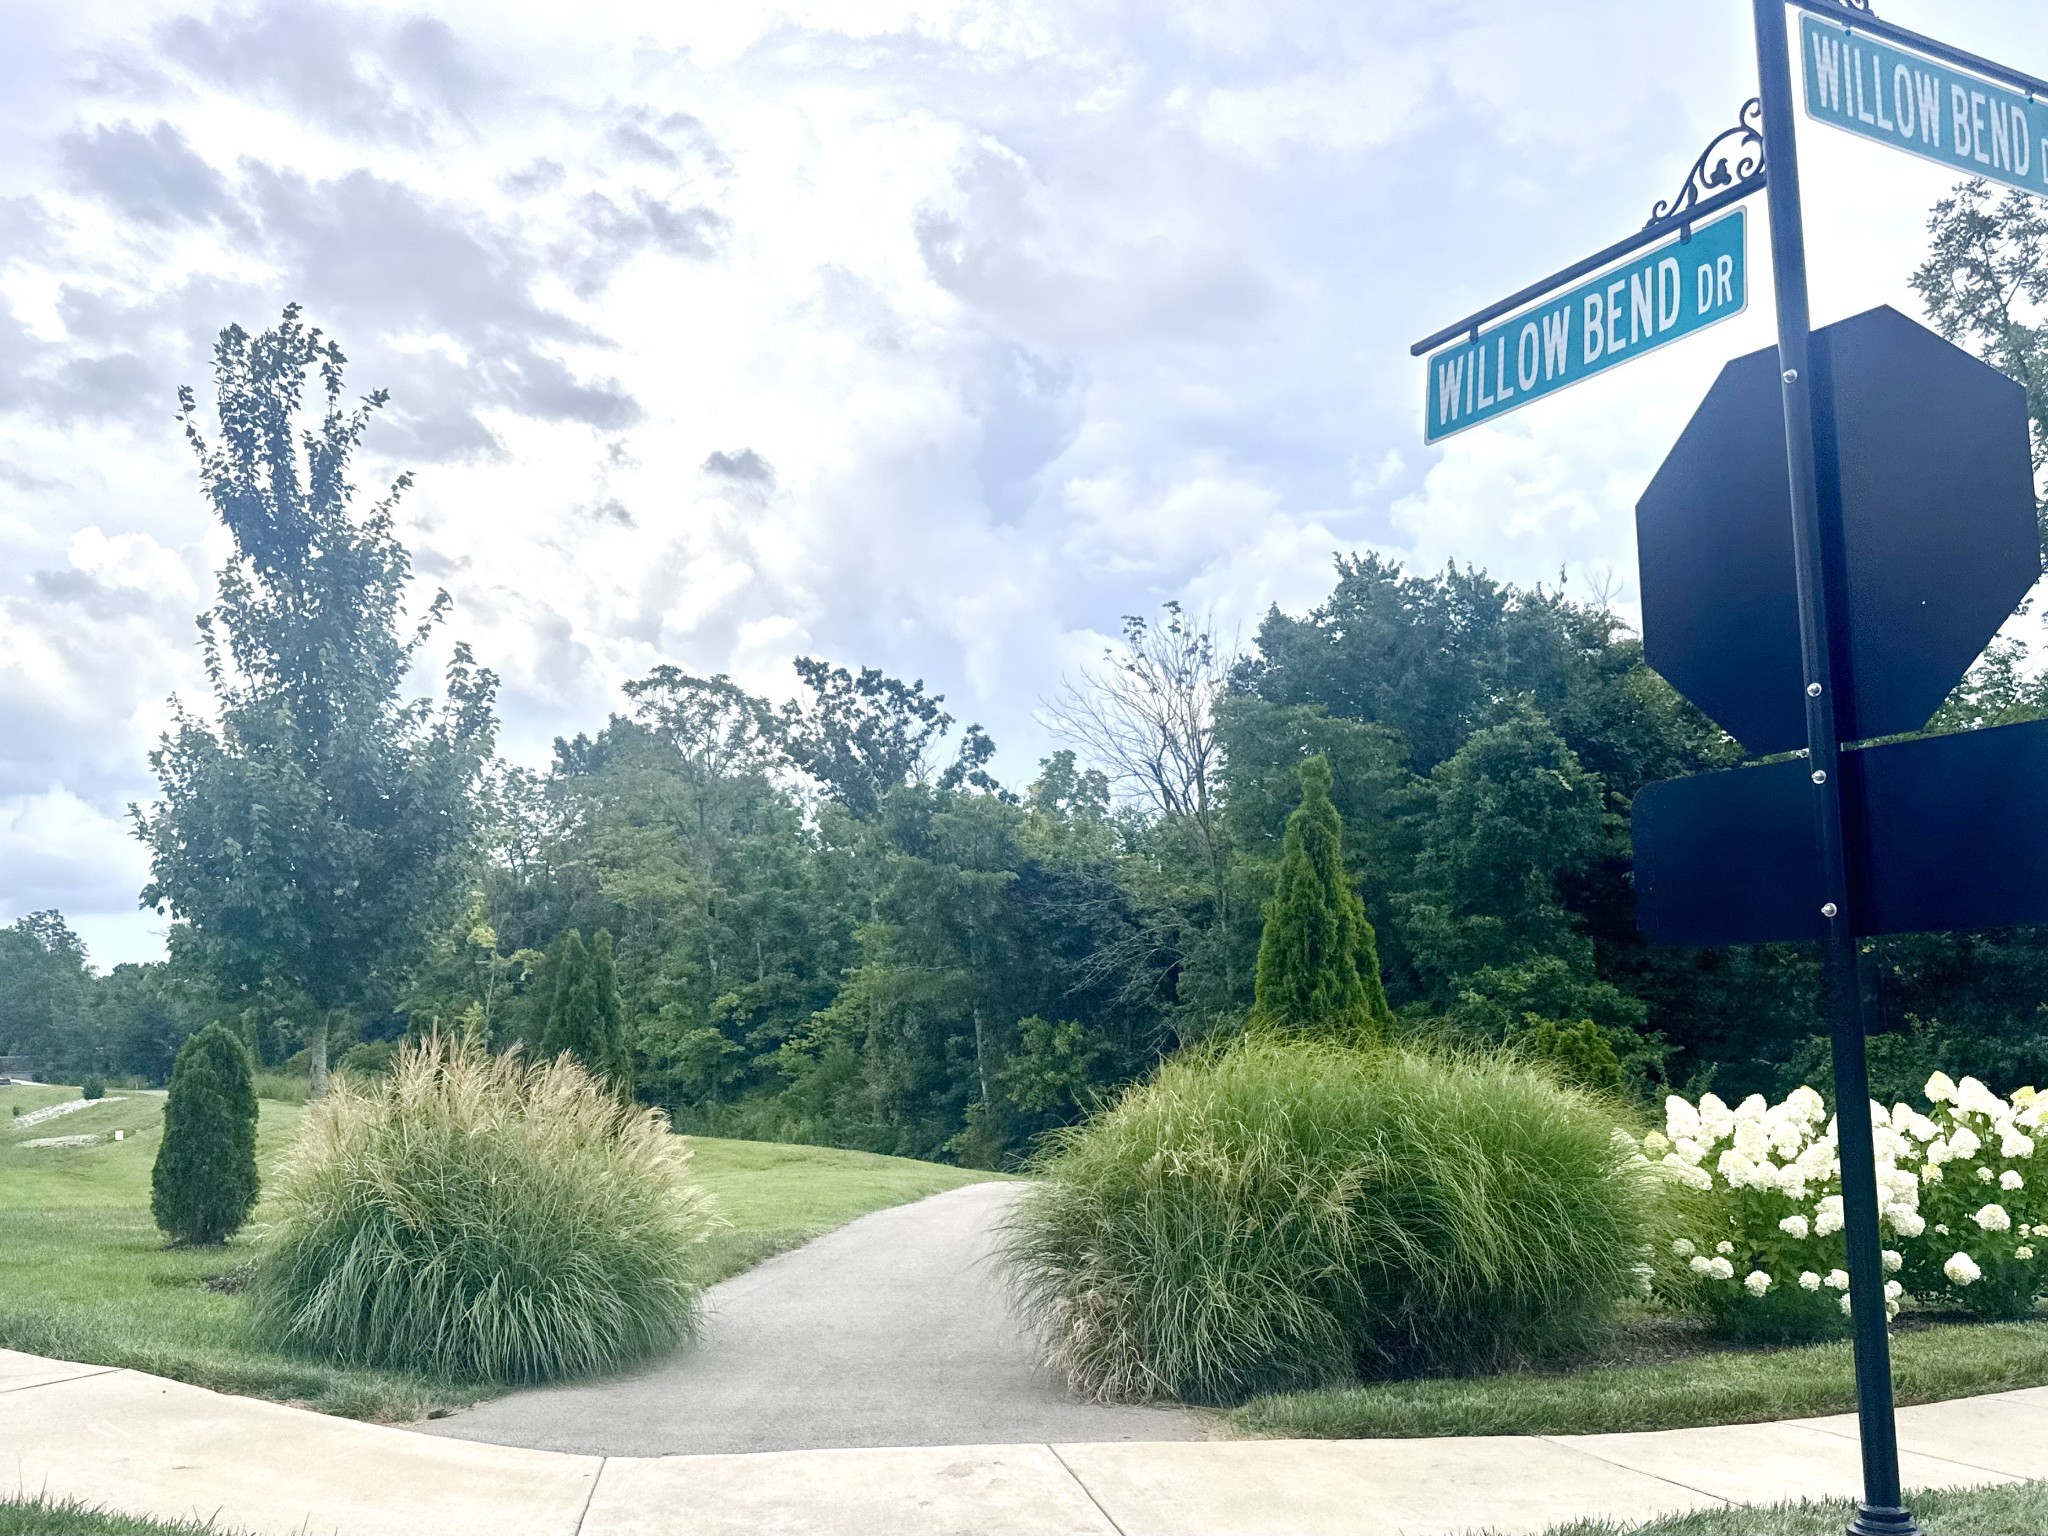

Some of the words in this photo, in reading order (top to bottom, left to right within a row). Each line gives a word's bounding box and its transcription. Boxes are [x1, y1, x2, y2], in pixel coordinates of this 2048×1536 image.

[1812, 32, 1940, 148] WILLOW
[1951, 84, 2030, 176] BEND
[1438, 305, 1571, 426] WILLOW
[1583, 257, 1680, 365] BEND
[1698, 254, 1733, 315] DR
